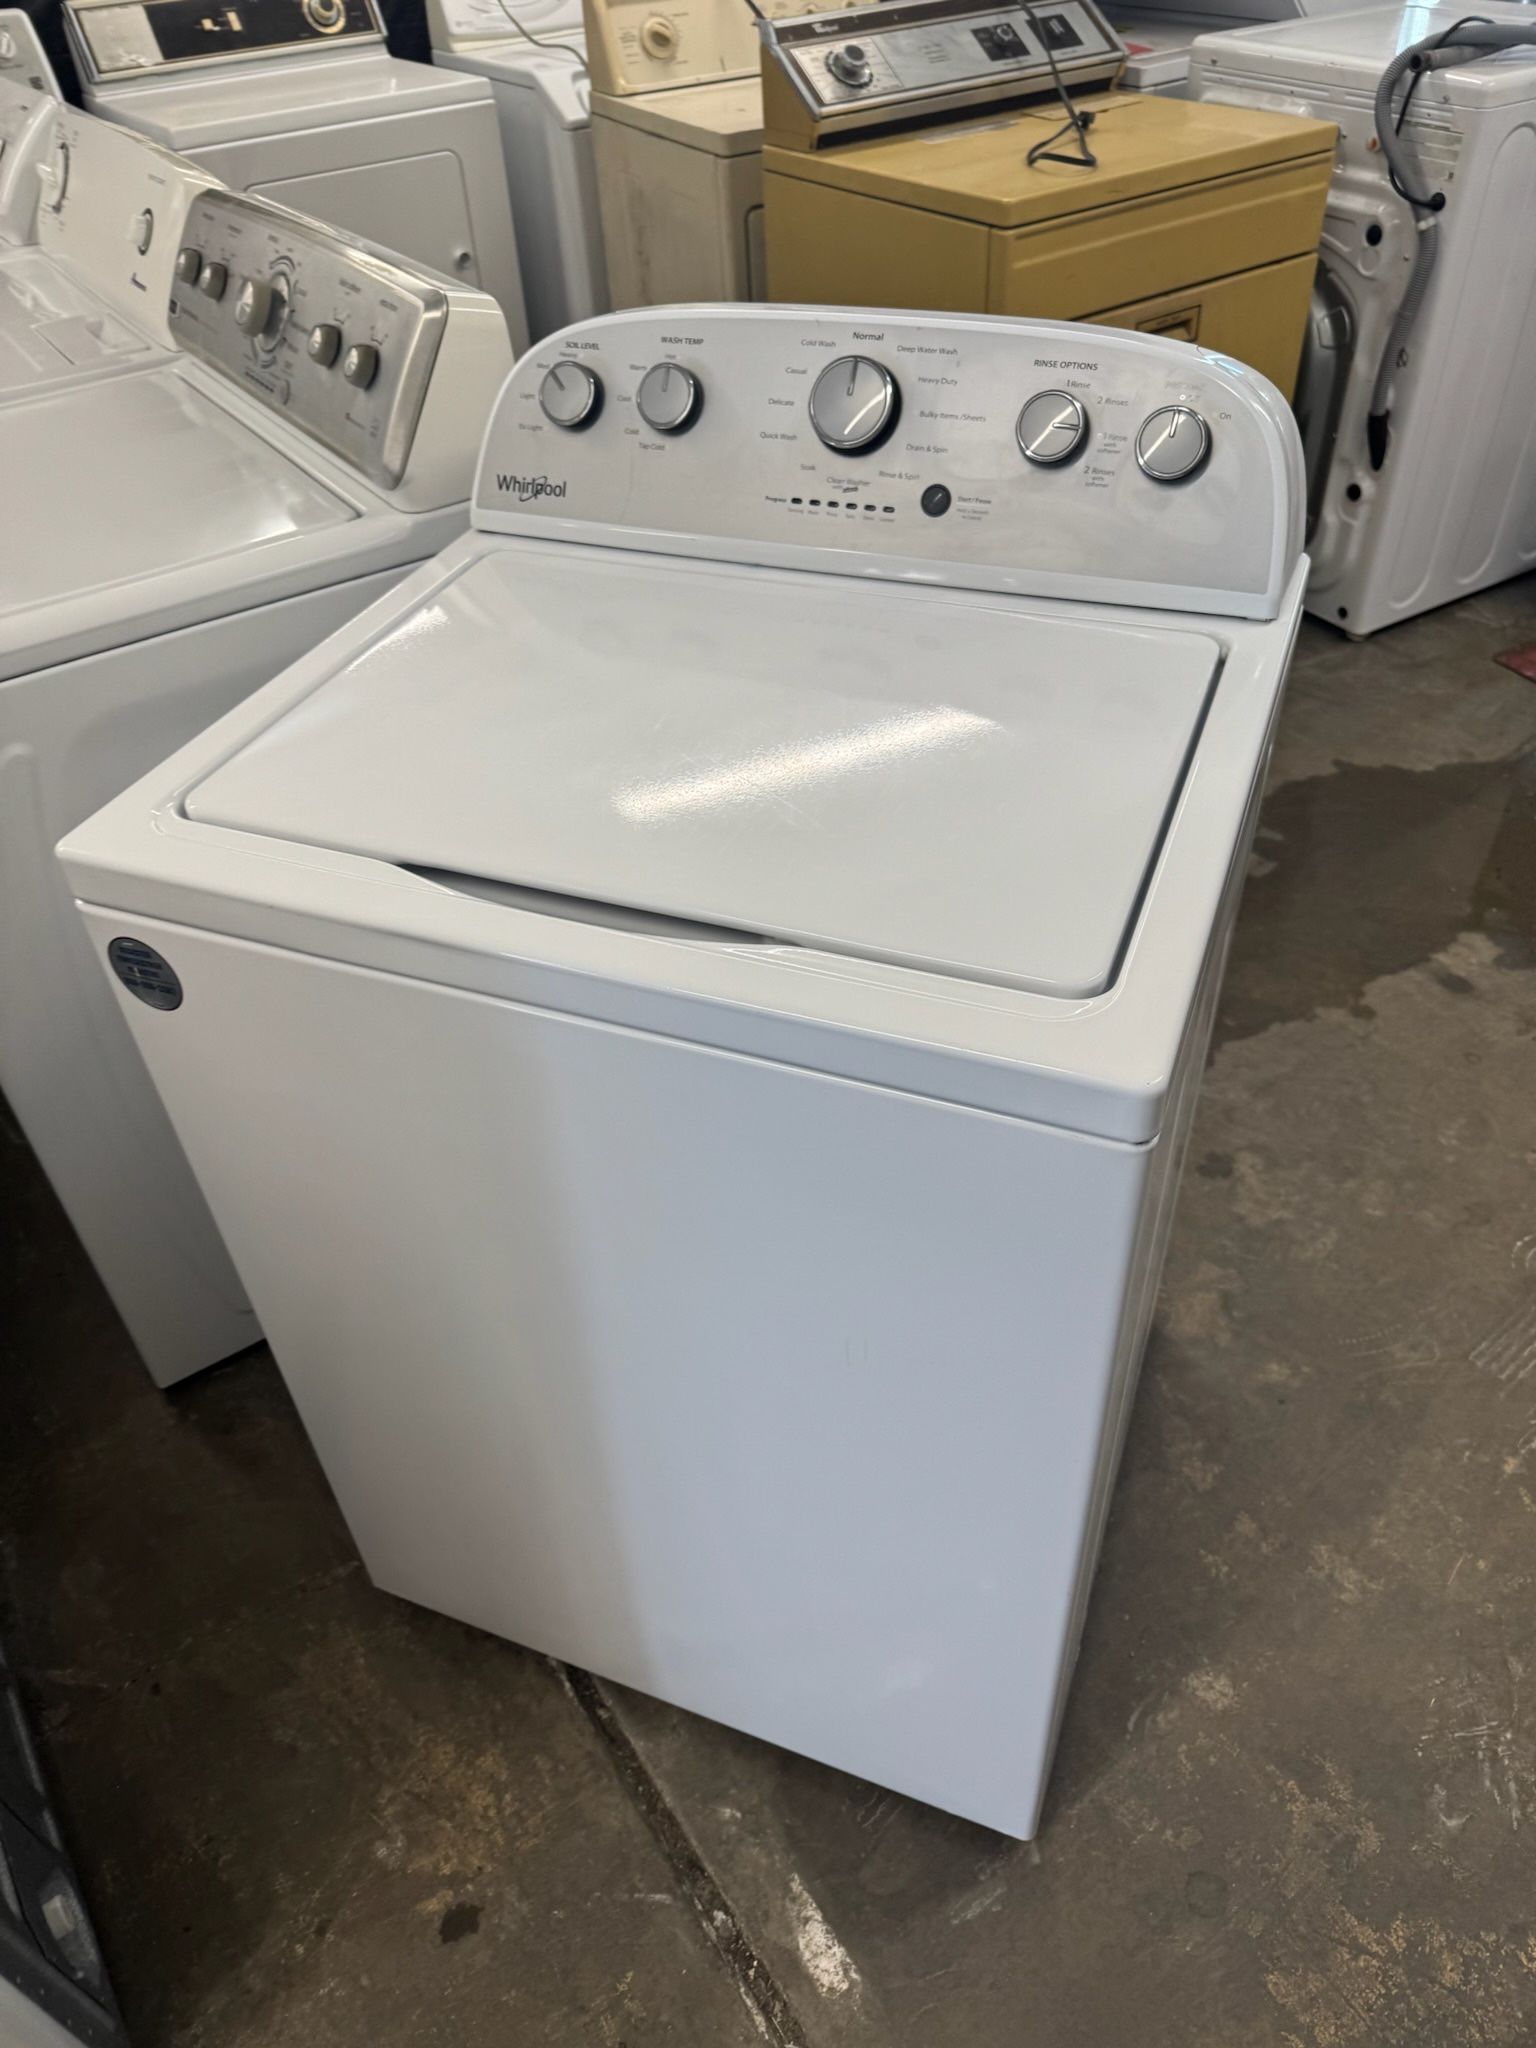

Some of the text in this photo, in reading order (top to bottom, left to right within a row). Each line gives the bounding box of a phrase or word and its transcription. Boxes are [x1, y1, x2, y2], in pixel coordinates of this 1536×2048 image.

[661, 336, 683, 345] WASH
[853, 332, 884, 341] Normal
[580, 342, 599, 350] LEVEL
[897, 345, 916, 354] Deep
[938, 347, 958, 355] Wash
[1034, 359, 1098, 371] RINSE OPTIONS
[918, 377, 958, 386] Heavy Duty
[768, 398, 795, 406] Delicate
[1097, 396, 1129, 406] 2 Rinses
[920, 411, 938, 419] Bulky
[1219, 412, 1232, 420] On
[760, 432, 778, 440] Quick
[905, 444, 925, 452] Drain
[1084, 466, 1090, 474] 2
[497, 473, 567, 502] Whirlpool
